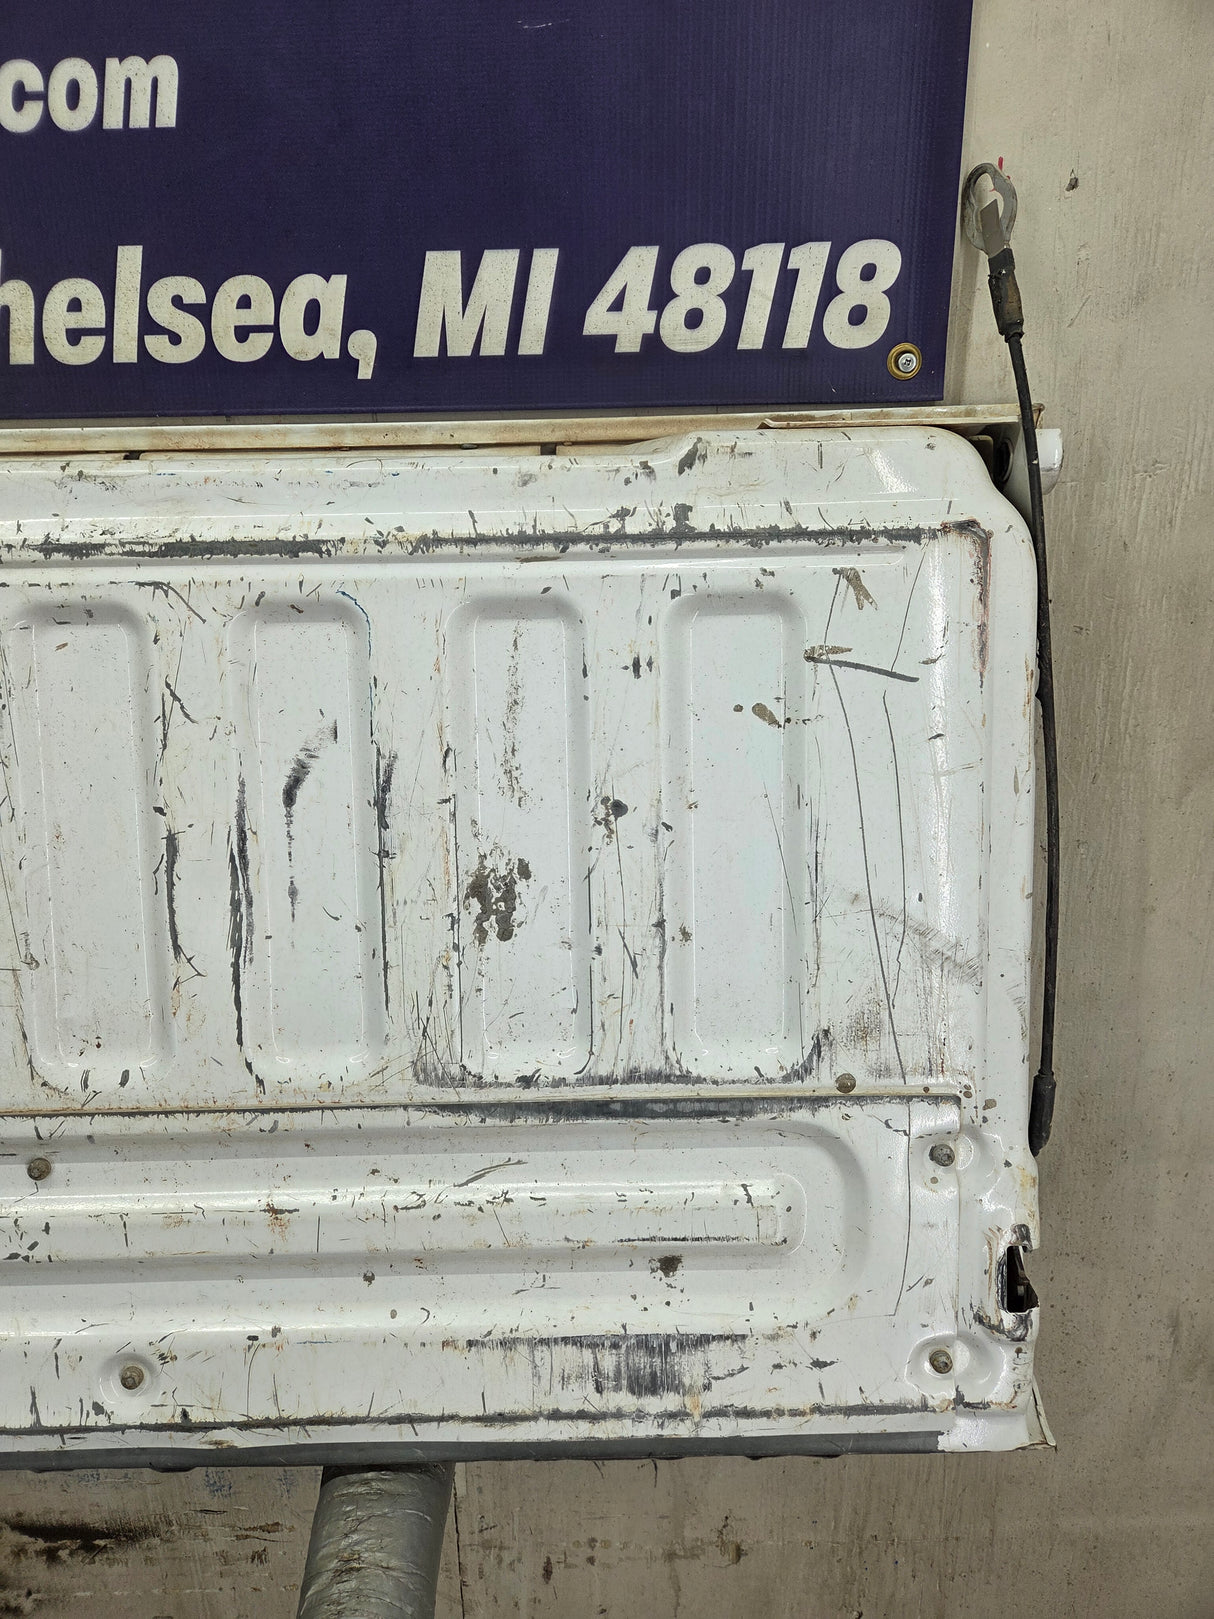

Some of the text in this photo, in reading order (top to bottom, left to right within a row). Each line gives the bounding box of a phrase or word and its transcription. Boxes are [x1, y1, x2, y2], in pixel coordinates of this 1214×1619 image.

[0, 54, 180, 133] com
[413, 247, 560, 358] MI
[582, 238, 902, 355] 48118
